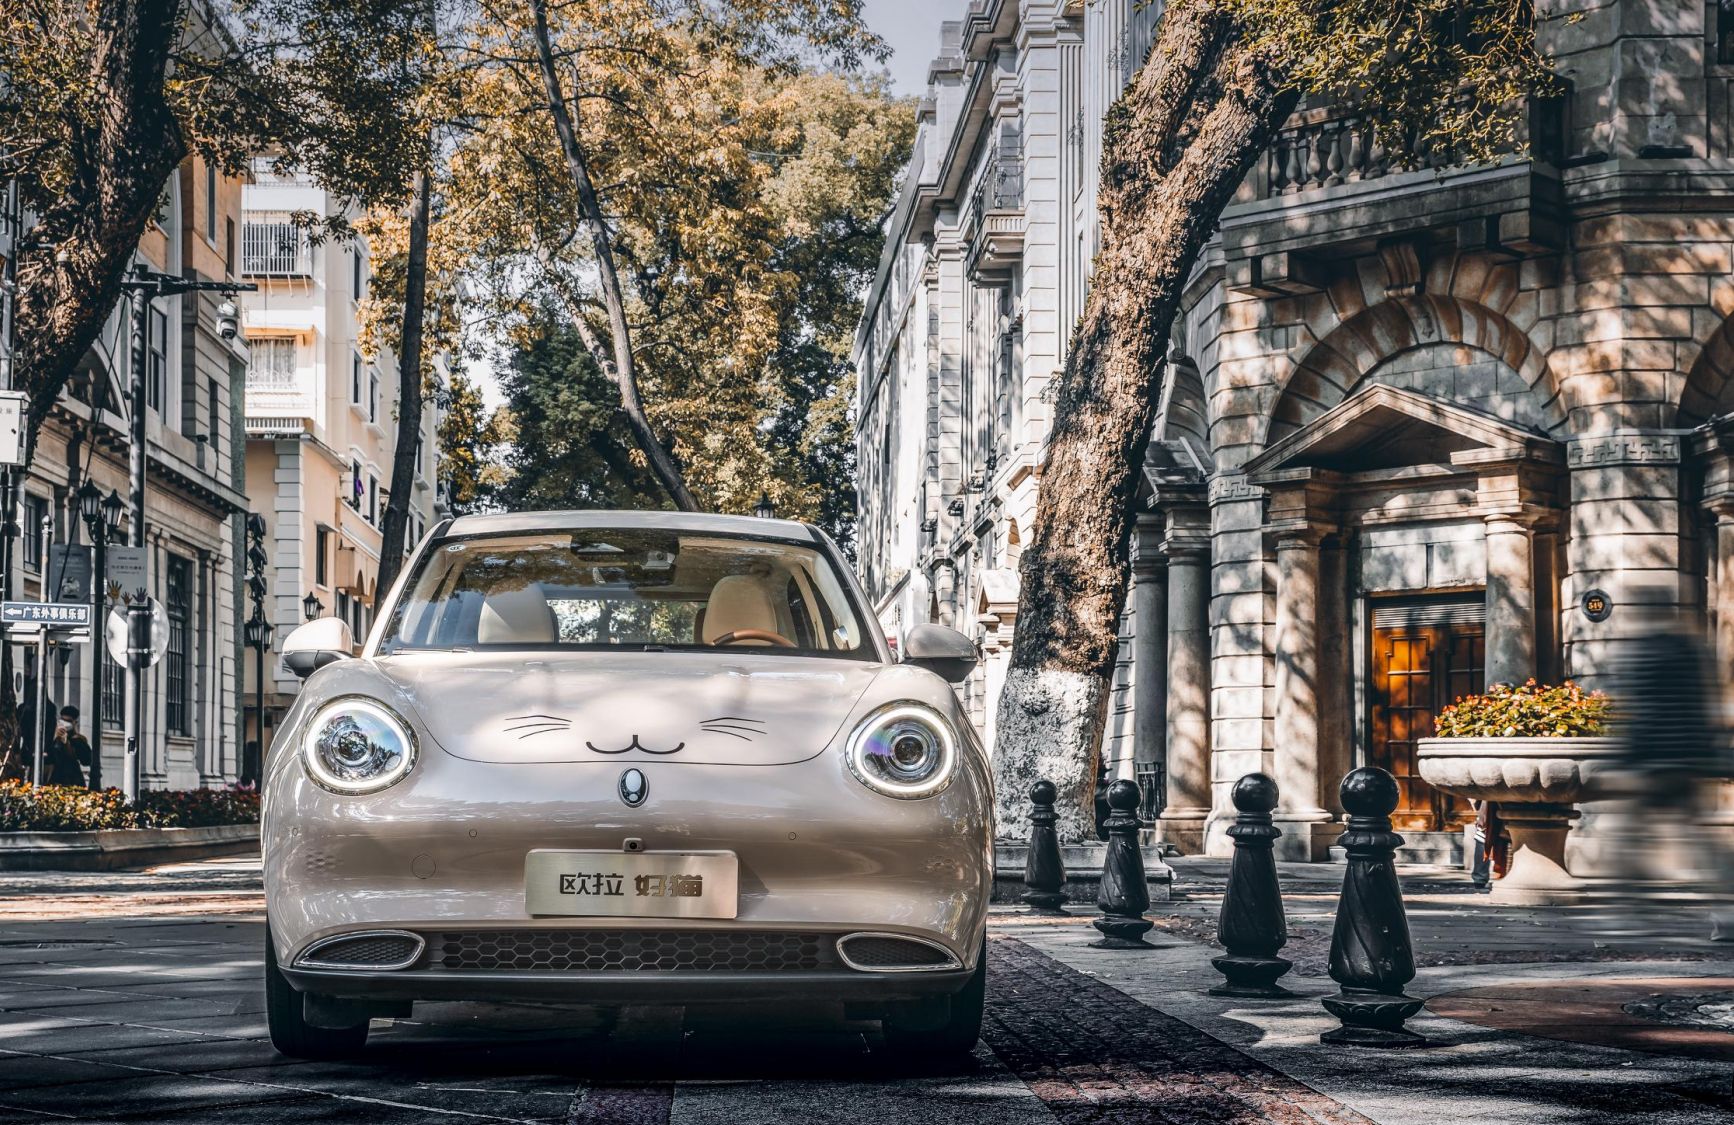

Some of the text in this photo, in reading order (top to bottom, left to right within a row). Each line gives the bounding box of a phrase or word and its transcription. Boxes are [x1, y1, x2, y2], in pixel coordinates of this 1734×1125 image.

[22, 606, 86, 621] 广东外事俱乐部
[559, 872, 703, 897] 欧拉 好猫
